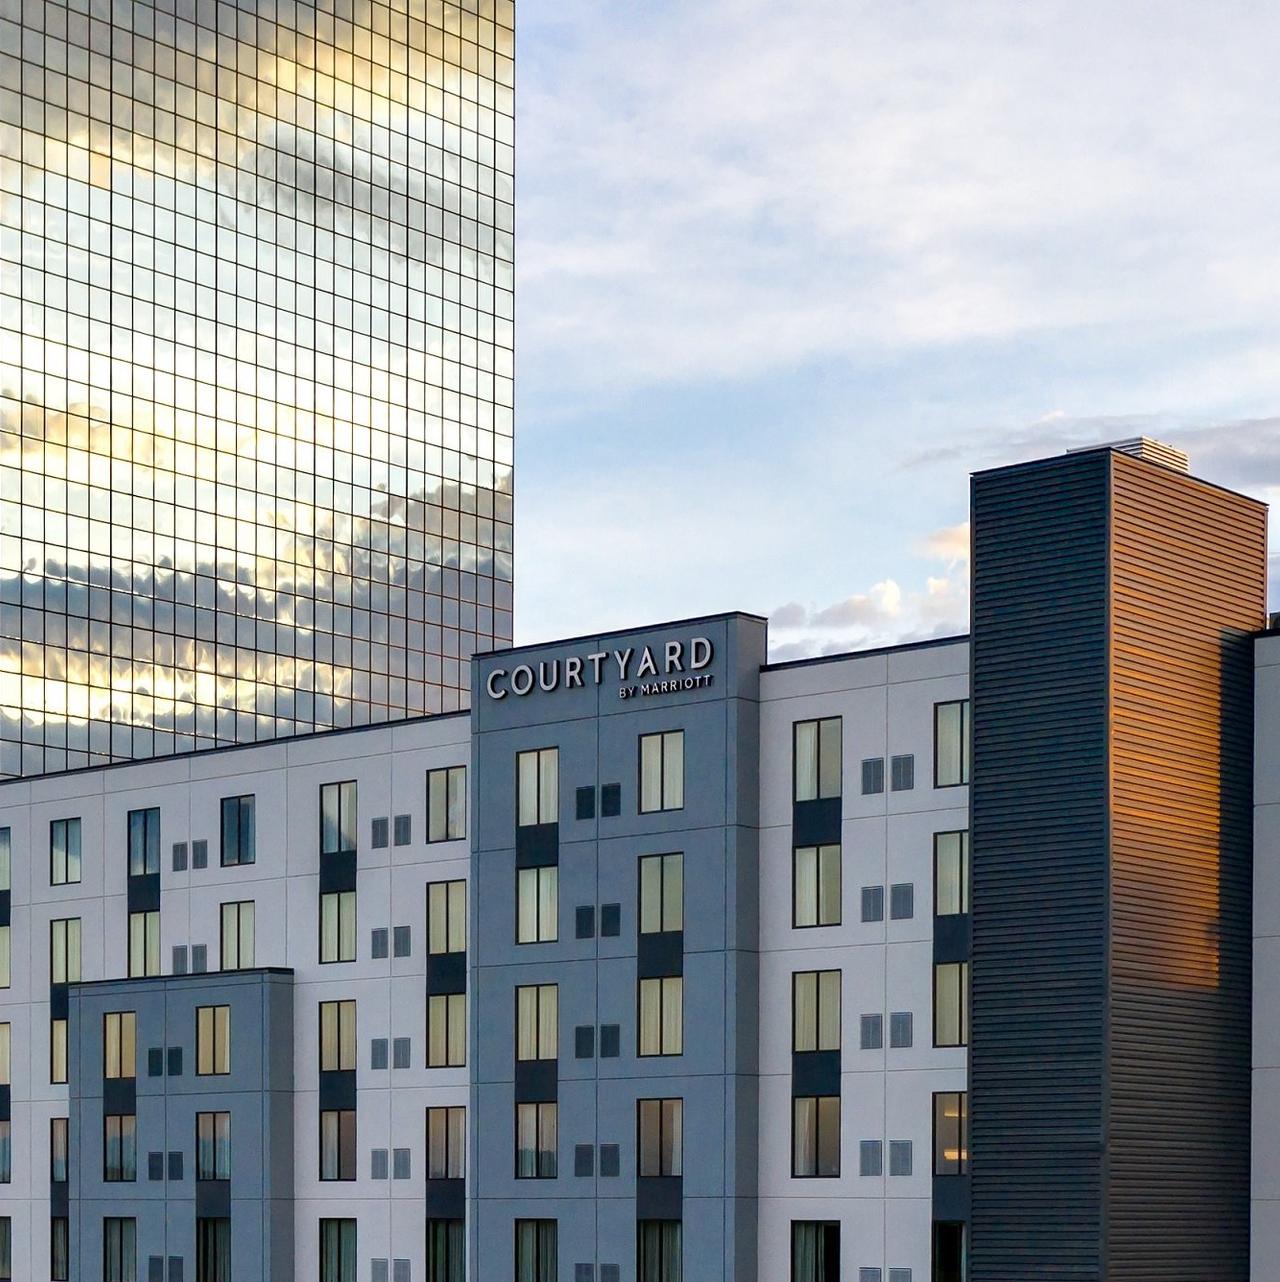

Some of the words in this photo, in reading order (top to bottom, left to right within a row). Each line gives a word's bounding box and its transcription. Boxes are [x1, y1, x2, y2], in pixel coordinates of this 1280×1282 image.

[486, 637, 714, 700] COURTYARD
[619, 687, 635, 699] BY
[640, 674, 711, 696] MARRIOTT
